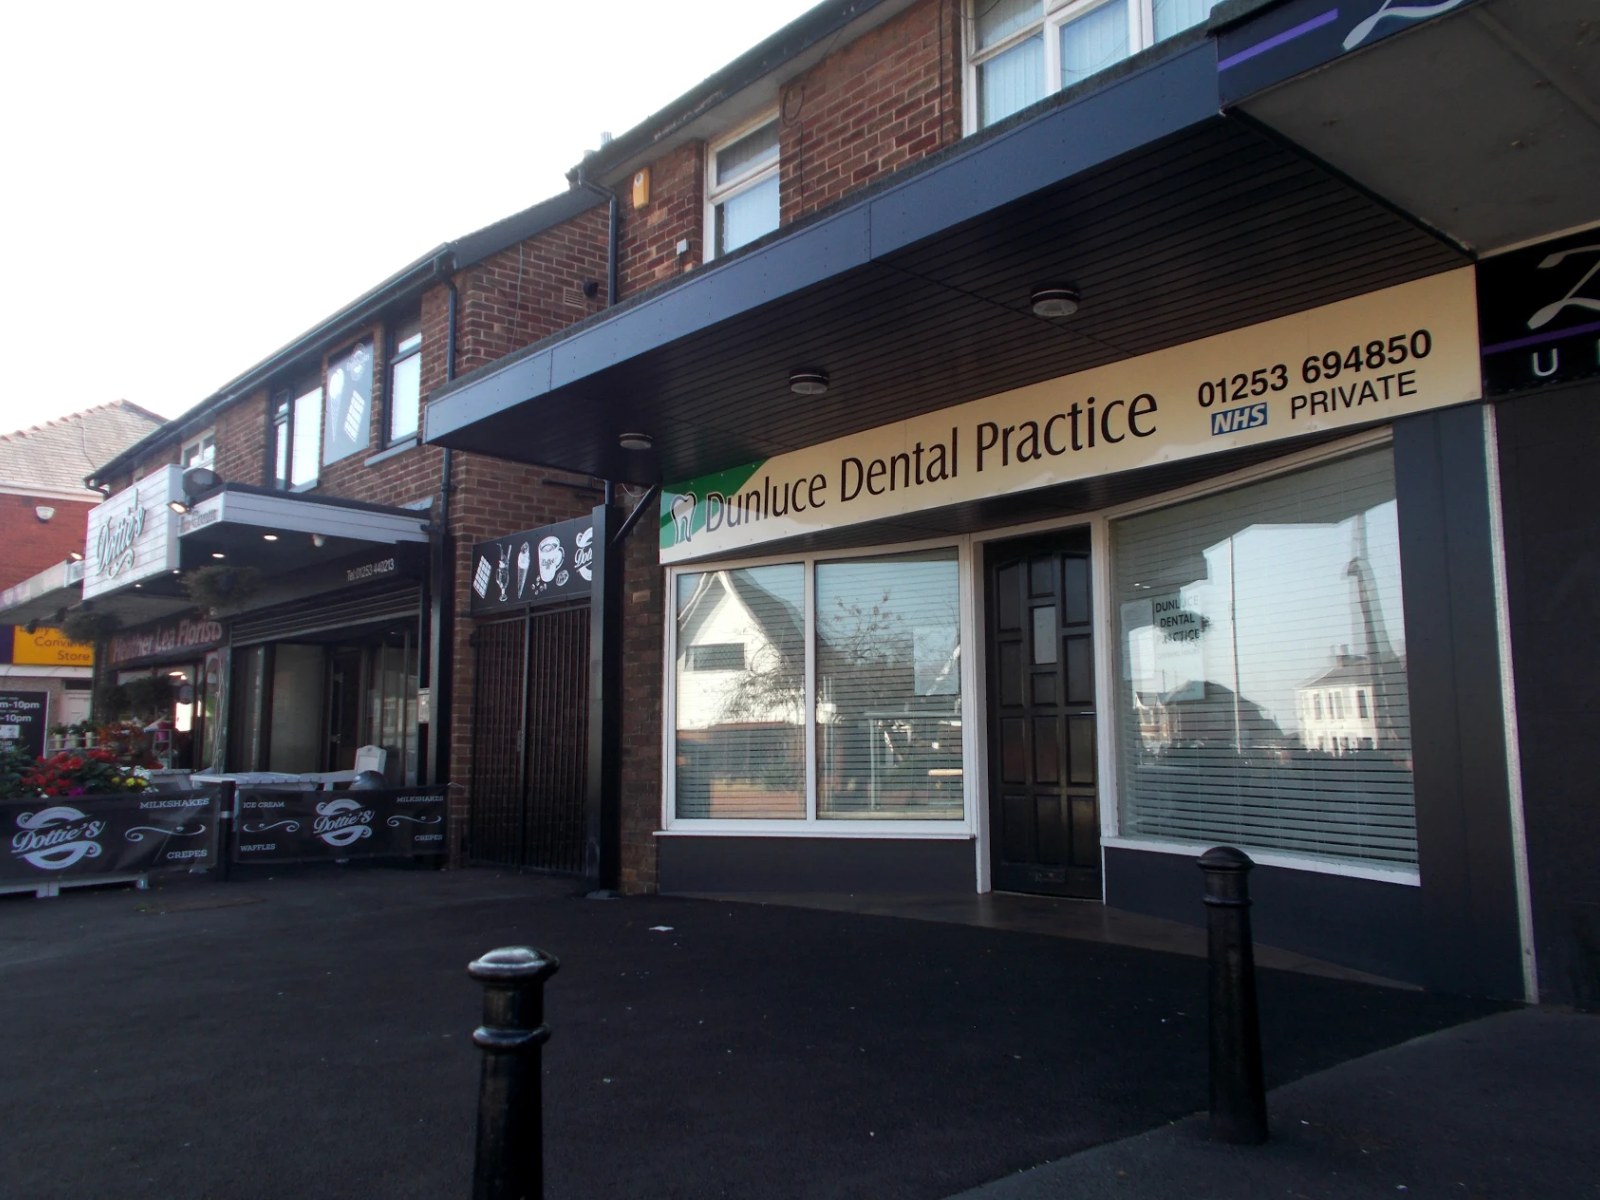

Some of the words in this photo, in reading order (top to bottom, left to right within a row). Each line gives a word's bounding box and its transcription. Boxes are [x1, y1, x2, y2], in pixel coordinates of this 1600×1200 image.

[1198, 363, 1288, 408] 01253
[1301, 328, 1432, 384] 694850
[1213, 403, 1266, 434] NHS
[1290, 369, 1417, 419] PRIVATE
[705, 473, 828, 533] Dunluce
[840, 427, 959, 502] Dental
[976, 393, 1159, 472] Practice
[1160, 613, 1196, 628] DENTAL
[57, 651, 90, 662] Store
[140, 797, 209, 809] MILKSHAKES
[166, 849, 208, 859] CREPES
[240, 844, 276, 852] WAFFLES
